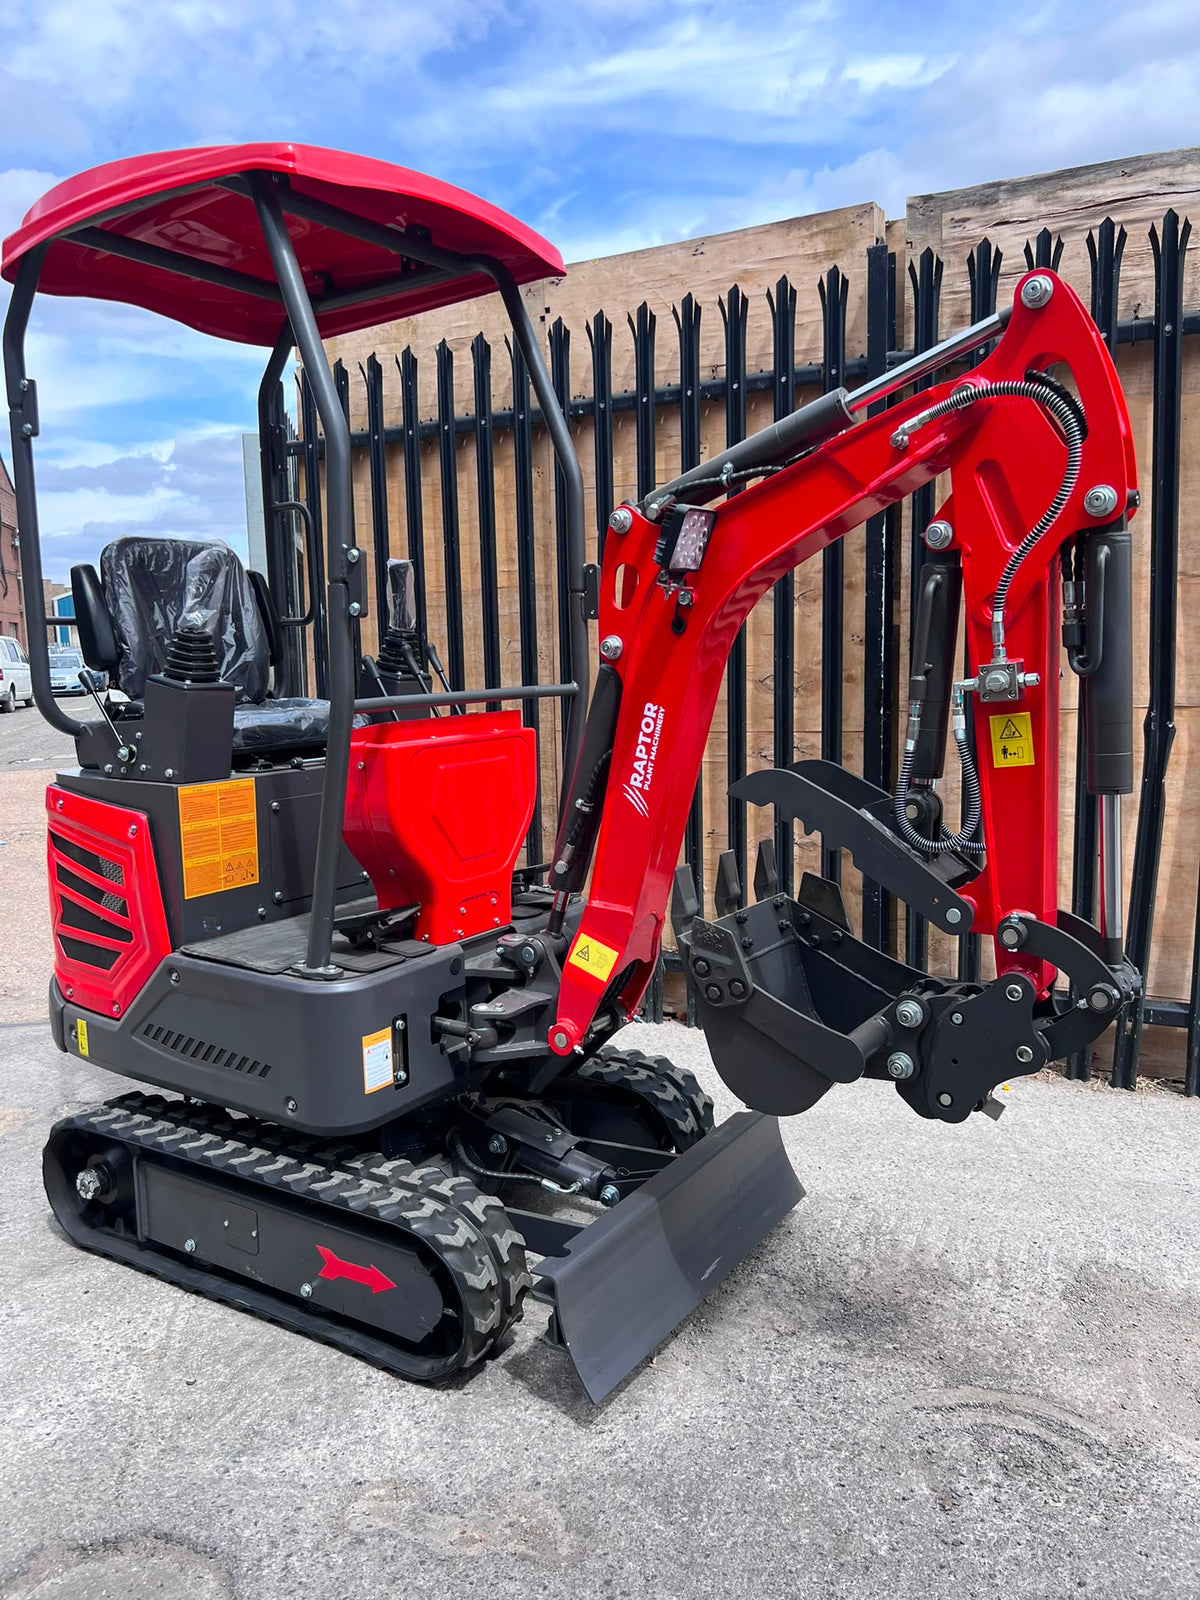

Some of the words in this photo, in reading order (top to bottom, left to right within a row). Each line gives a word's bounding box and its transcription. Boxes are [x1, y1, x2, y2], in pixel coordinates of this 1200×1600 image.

[630, 702, 658, 788] RAPTOR
[643, 762, 655, 791] PLANT
[651, 706, 666, 760] MACHINERY
